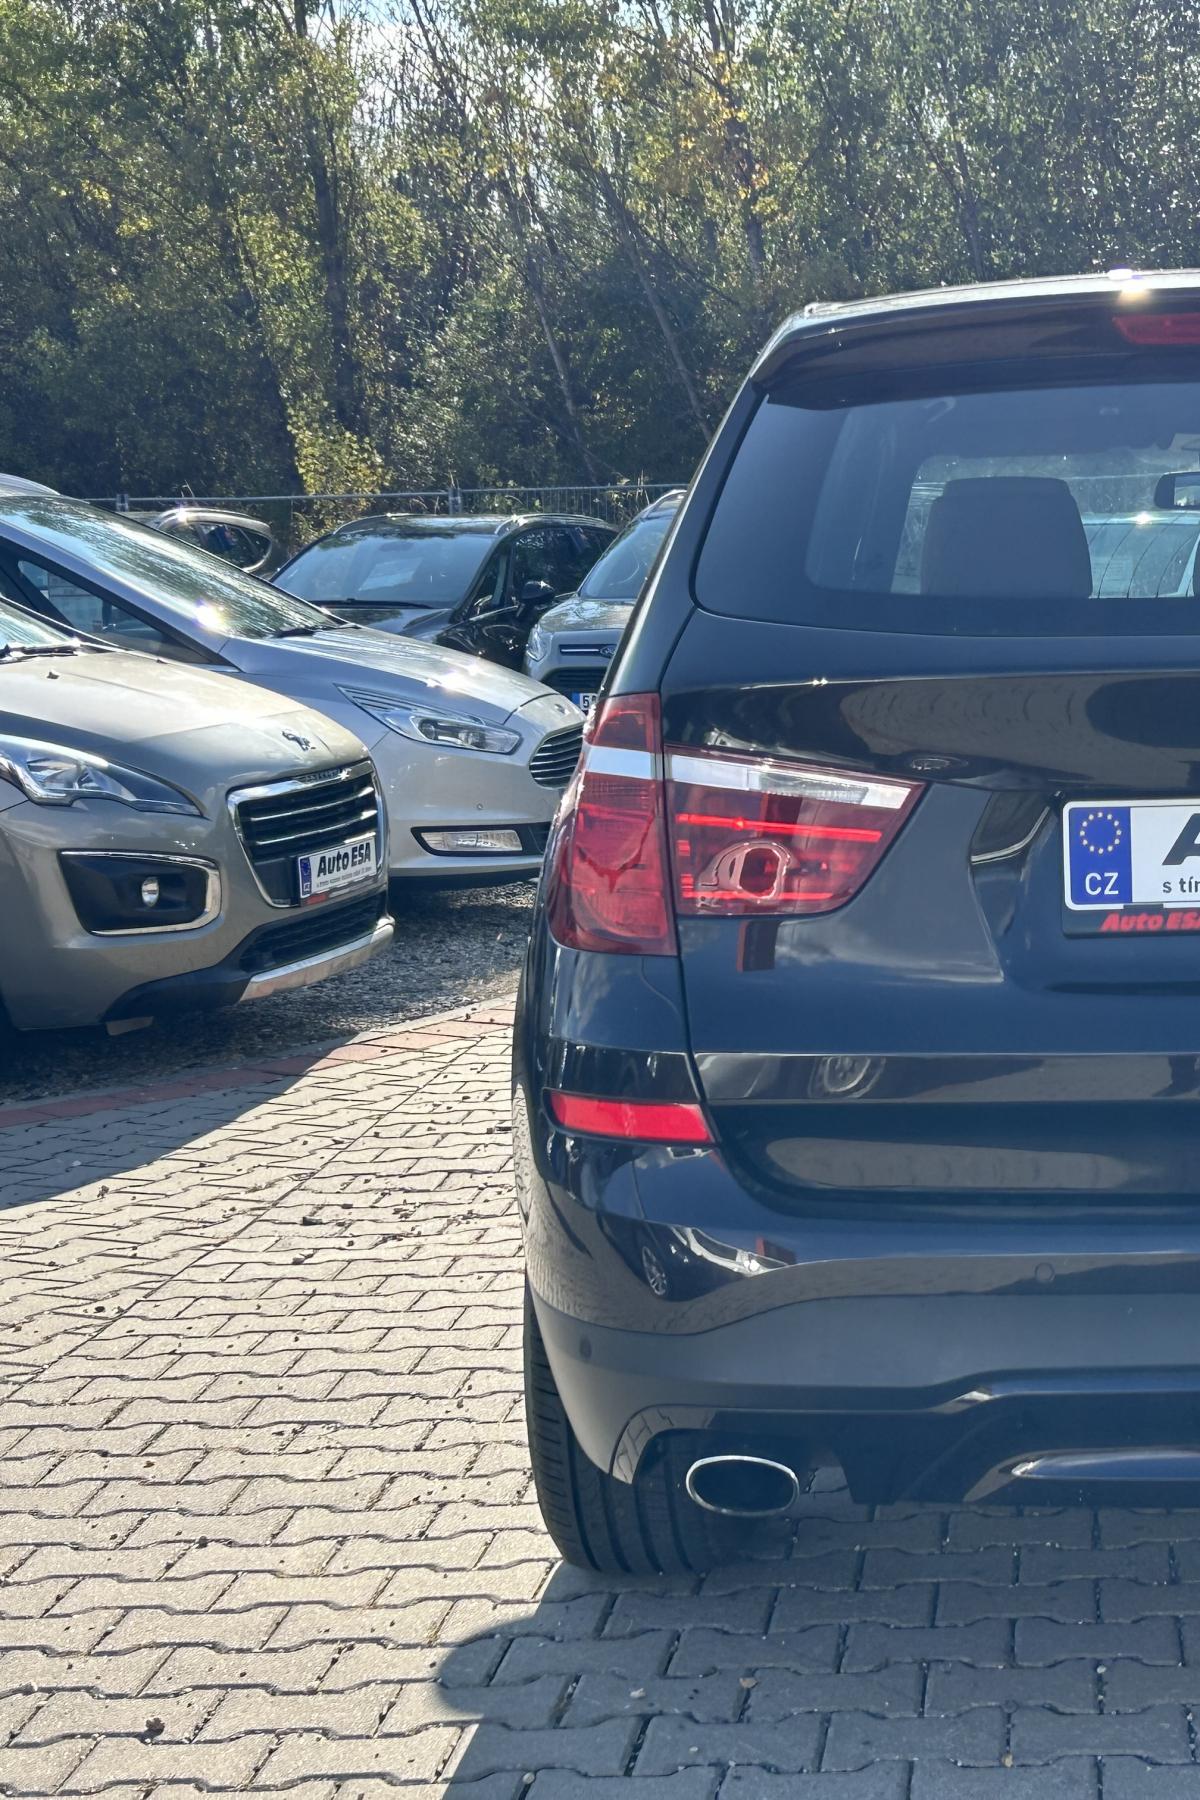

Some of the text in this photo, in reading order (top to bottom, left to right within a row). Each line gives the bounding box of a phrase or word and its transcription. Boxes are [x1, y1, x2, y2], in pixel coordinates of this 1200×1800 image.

[317, 850, 350, 878] Auto
[351, 842, 371, 868] ESA
[1085, 872, 1119, 896] CZ
[1162, 881, 1172, 894] s
[1100, 912, 1164, 932] Auto
